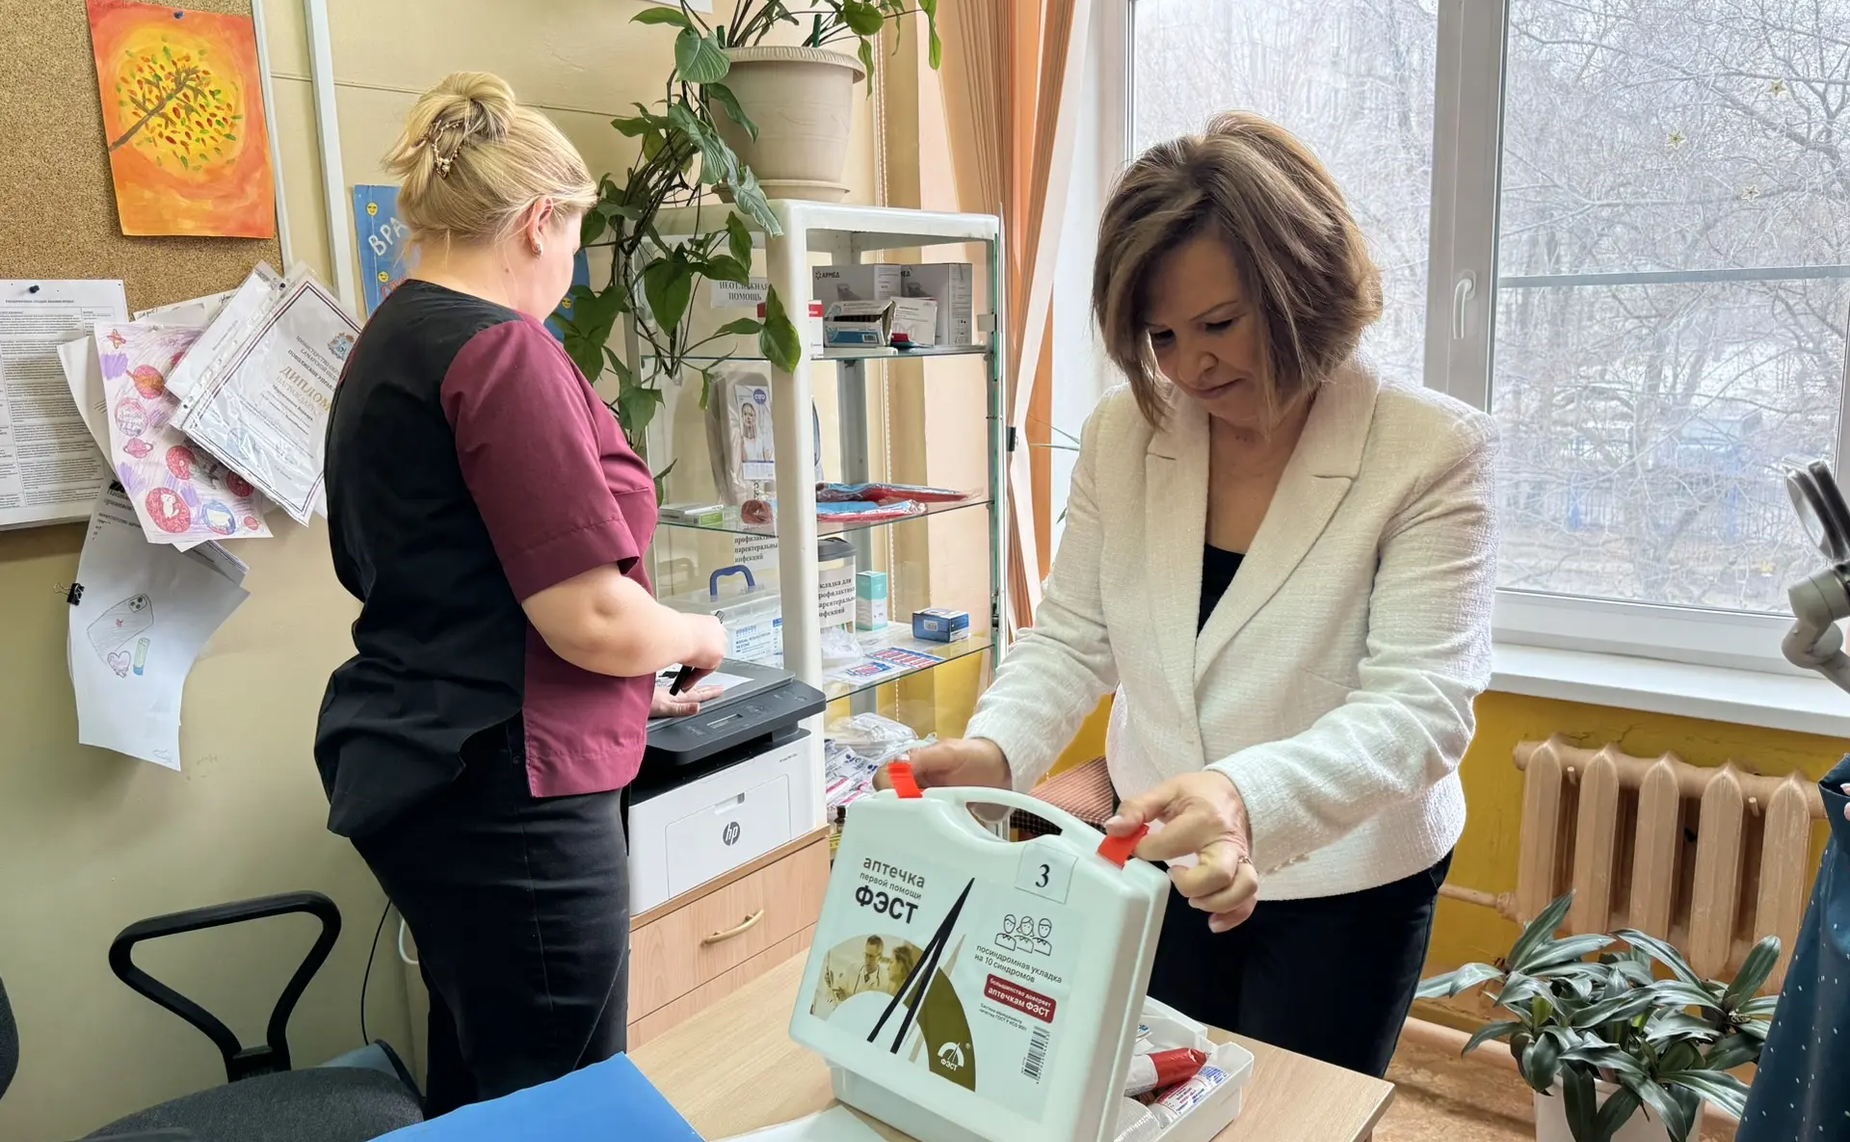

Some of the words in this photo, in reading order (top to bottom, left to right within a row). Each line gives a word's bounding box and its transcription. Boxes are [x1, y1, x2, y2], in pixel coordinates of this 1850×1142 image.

[368, 217, 409, 256] ВРА
[728, 292, 762, 301] ПОМОЩЬ
[280, 366, 331, 411] ДИПЛОМ
[819, 580, 841, 589] кладка
[723, 822, 740, 846] hp
[859, 872, 888, 888] первой
[889, 882, 922, 900] помощи
[863, 857, 925, 888] аптечка
[1035, 863, 1050, 888] 3
[855, 884, 919, 924] ФЭСТ
[975, 954, 983, 962] на
[985, 956, 994, 966] 10
[993, 962, 1036, 983] синдромов
[976, 945, 1031, 970] посиндромная
[1031, 966, 1063, 983] укладка
[988, 987, 1026, 1008] аптечкам
[1025, 1002, 1050, 1018] ФЭСТ
[940, 1058, 958, 1072] ФЭСТ
